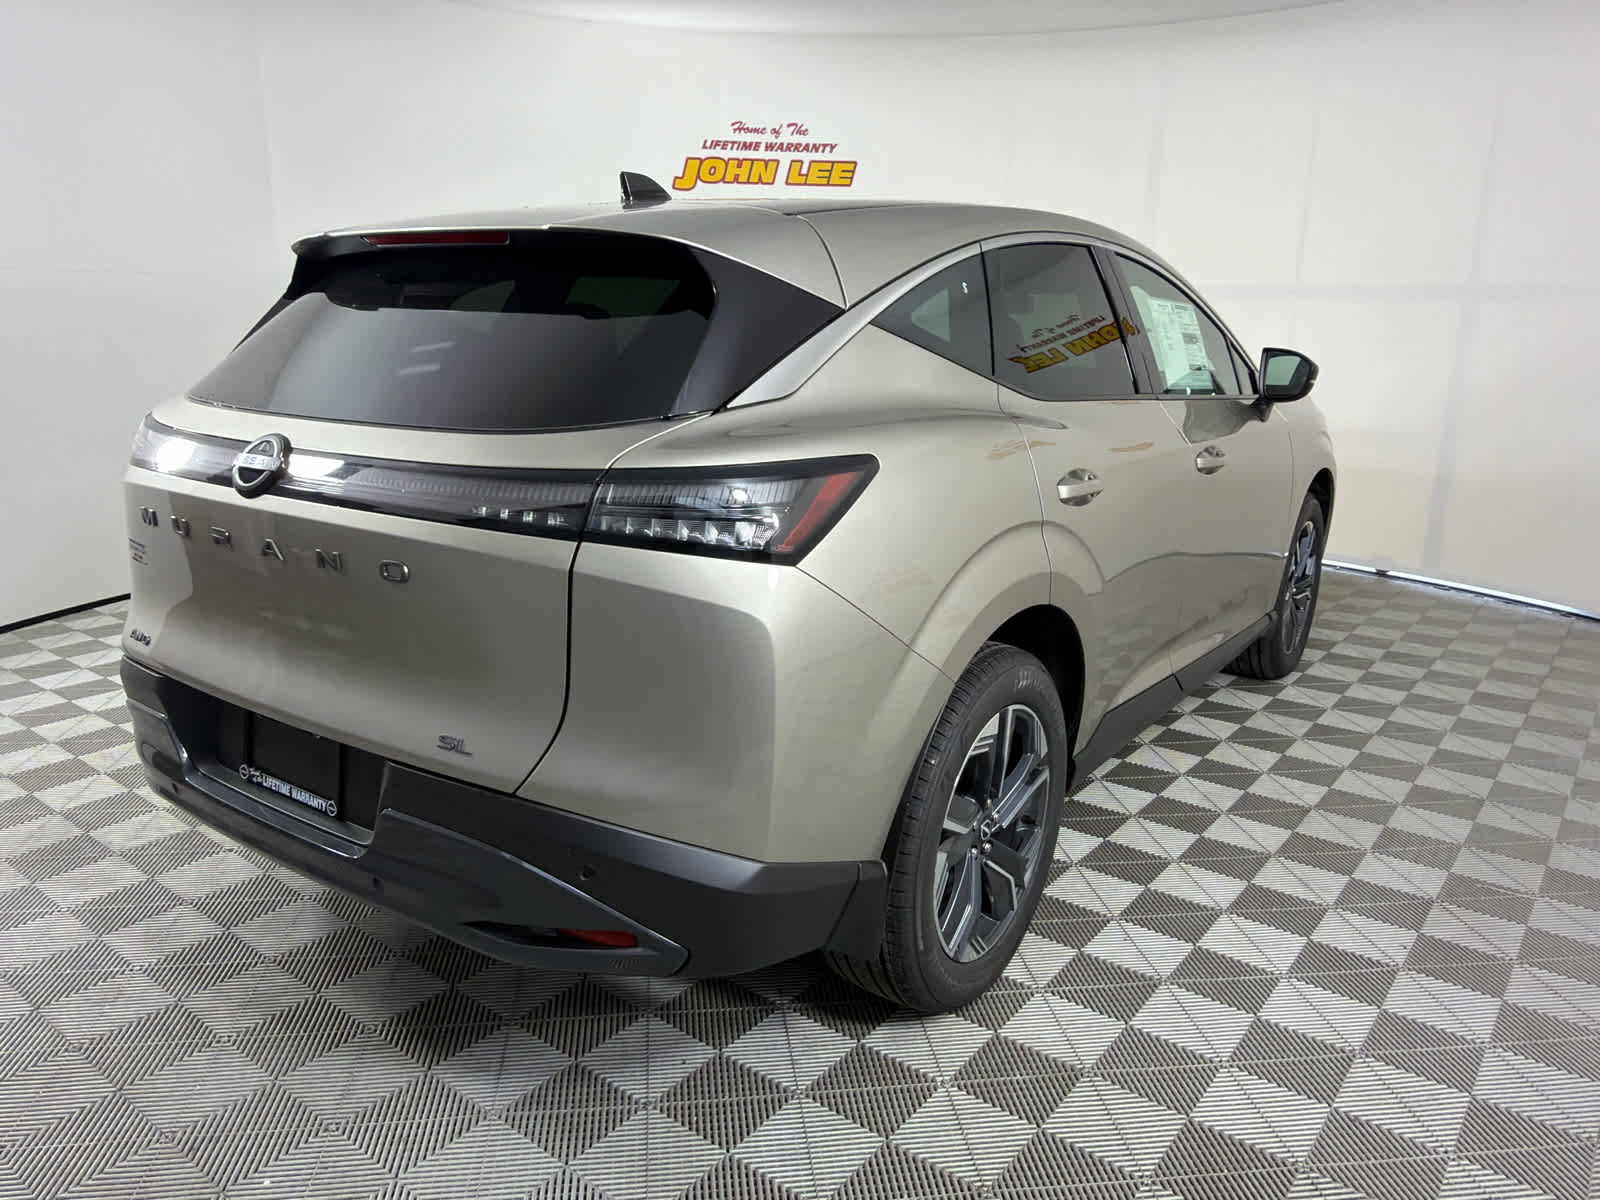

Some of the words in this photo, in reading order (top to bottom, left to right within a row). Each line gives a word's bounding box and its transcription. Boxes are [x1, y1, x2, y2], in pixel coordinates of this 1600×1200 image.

[731, 120, 766, 135] Home
[770, 124, 783, 139] of
[786, 122, 809, 137] The
[701, 139, 762, 152] LIFETIME
[764, 140, 838, 154] WARRANTY
[672, 156, 780, 191] JOHN
[785, 159, 858, 188] LEE
[139, 505, 410, 584] MURANO
[436, 735, 473, 756] SL
[262, 773, 290, 796] LIFETIME
[290, 785, 326, 812] WARRANTY
